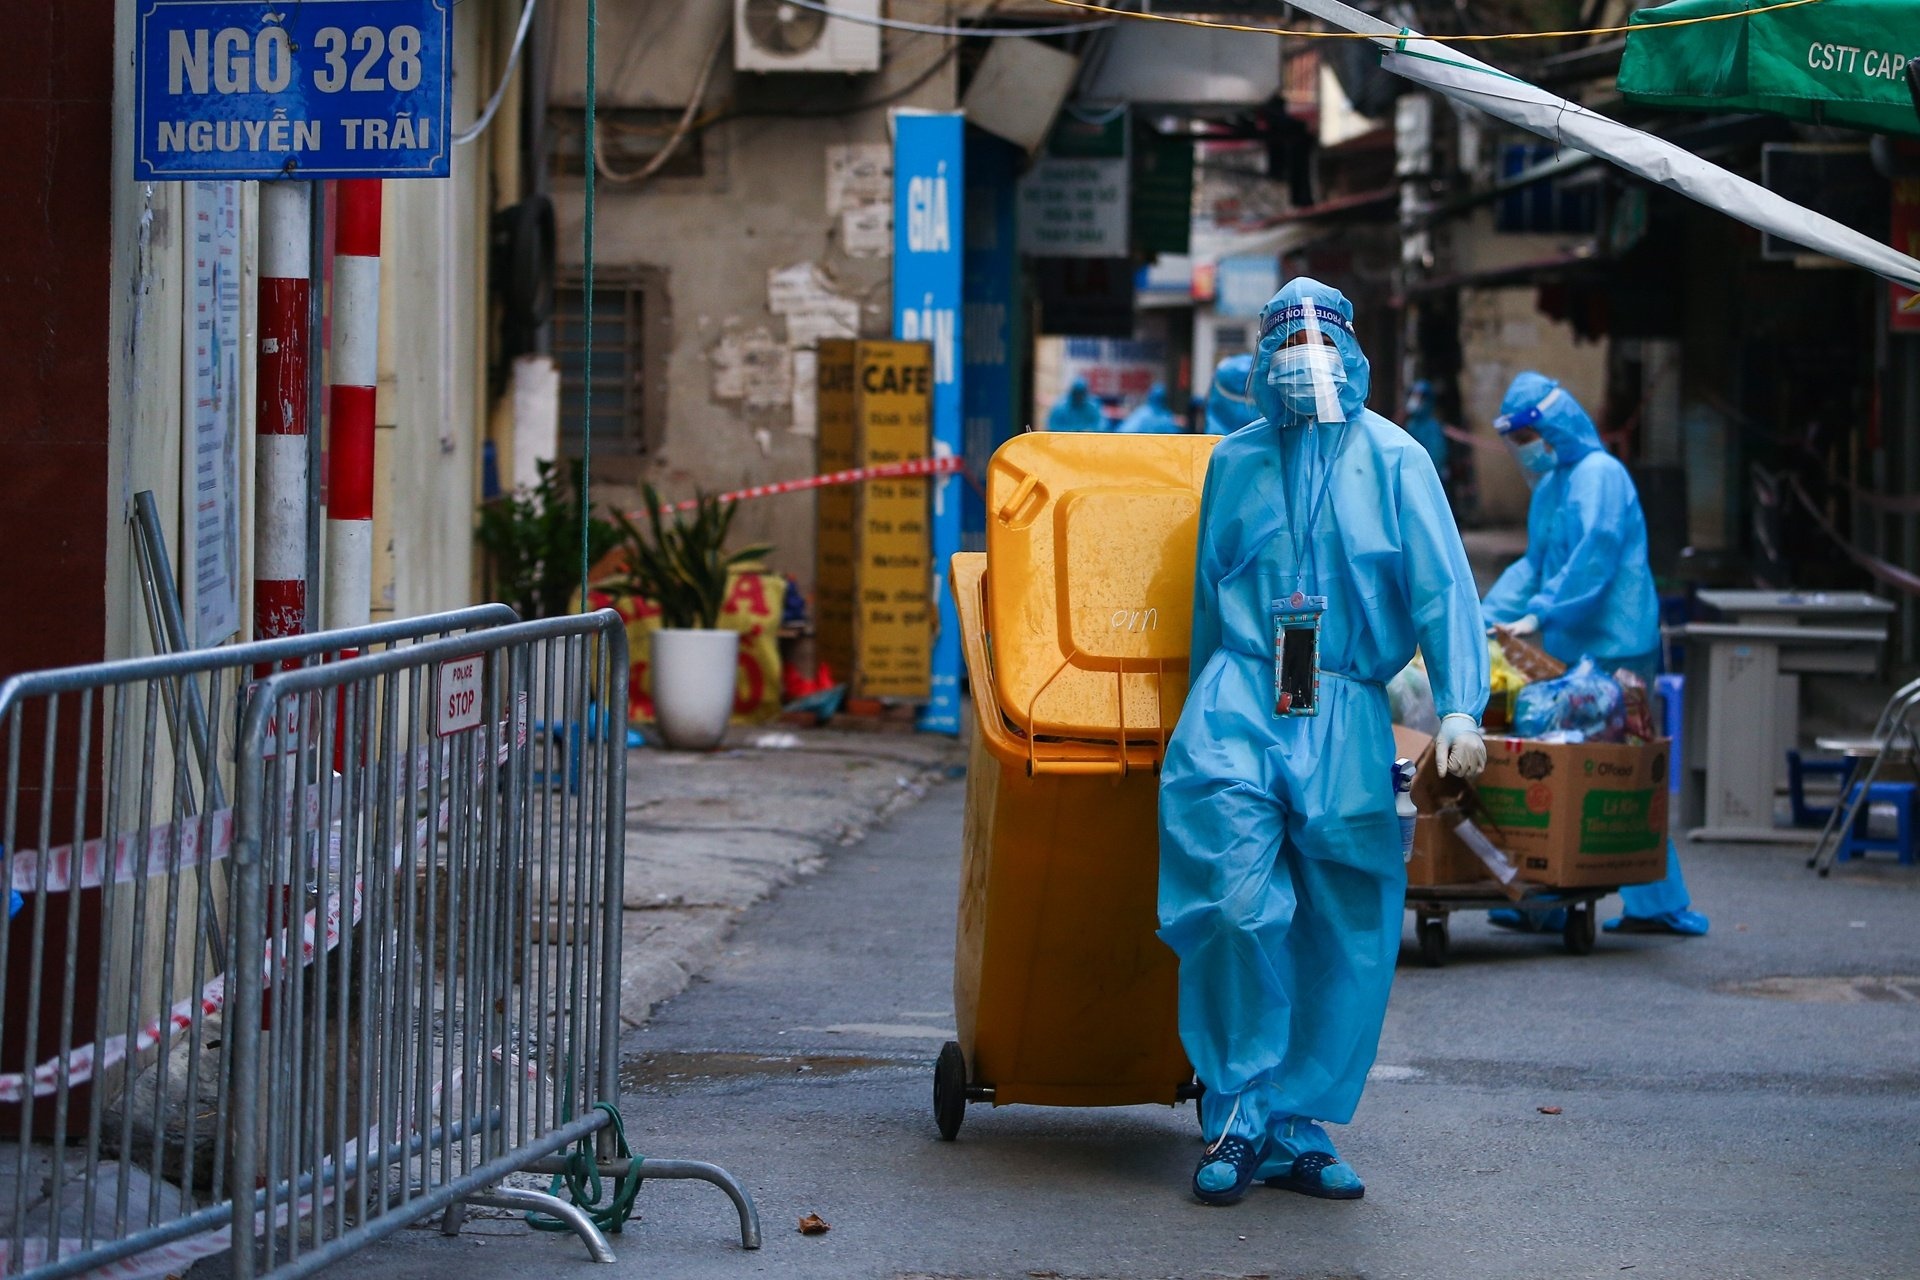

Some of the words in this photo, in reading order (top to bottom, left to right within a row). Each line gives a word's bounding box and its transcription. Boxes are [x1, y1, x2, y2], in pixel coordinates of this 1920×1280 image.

[168, 12, 291, 95] NGÕ
[313, 25, 422, 94] 328
[1808, 41, 1860, 73] CSTT
[1863, 50, 1906, 82] CAP.
[158, 108, 321, 153] NGUYỄN
[340, 111, 430, 150] TRÃI
[1286, 308, 1342, 325] PROTECTION
[863, 364, 929, 394] CAFE
[453, 664, 473, 681] POLICE
[448, 689, 475, 719] STOP
